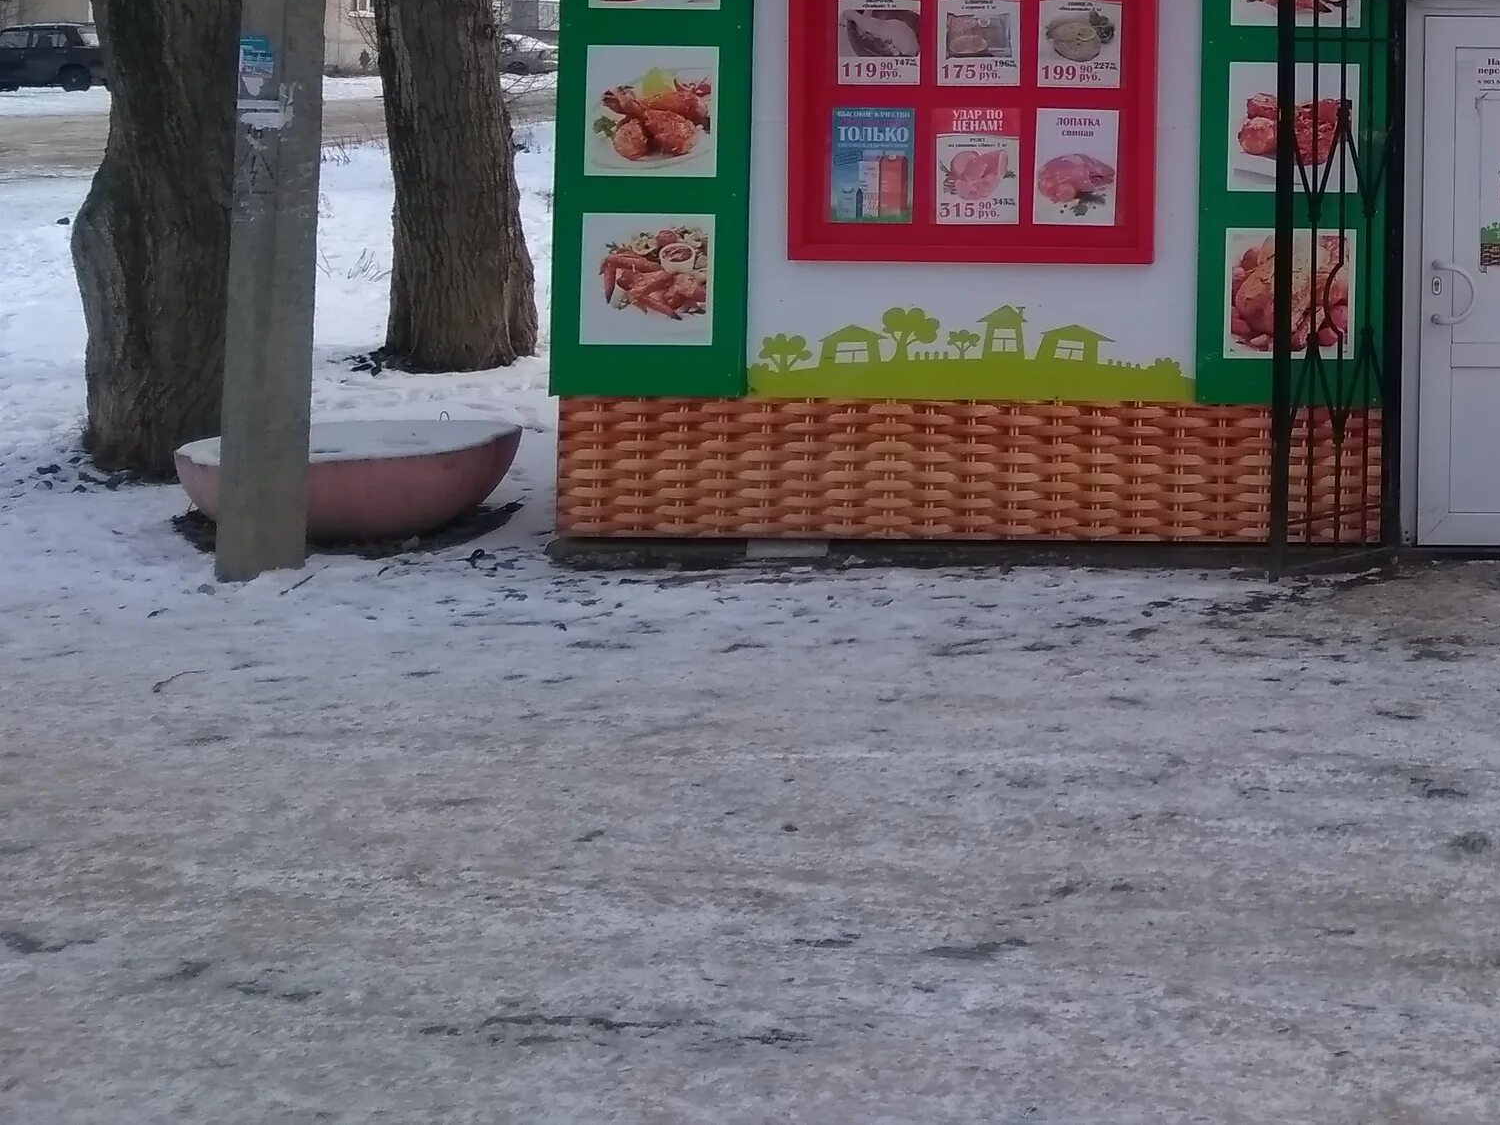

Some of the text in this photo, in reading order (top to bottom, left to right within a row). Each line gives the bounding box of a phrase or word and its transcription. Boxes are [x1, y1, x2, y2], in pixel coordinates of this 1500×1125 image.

[842, 61, 893, 78] 119 90
[880, 68, 901, 80] руб.
[941, 63, 992, 79] 175 90
[1042, 65, 1092, 81] 199 90
[979, 71, 1000, 81] руб.
[1079, 73, 1100, 82] руб.
[953, 109, 1003, 120] УДАР ПО
[953, 120, 1003, 132] ЦЕНАМ!
[1056, 117, 1100, 127] ЛОПАТКА
[838, 126, 909, 143] ТОЛЬКО
[940, 201, 991, 218] 315 90
[979, 209, 1000, 219] руб.
